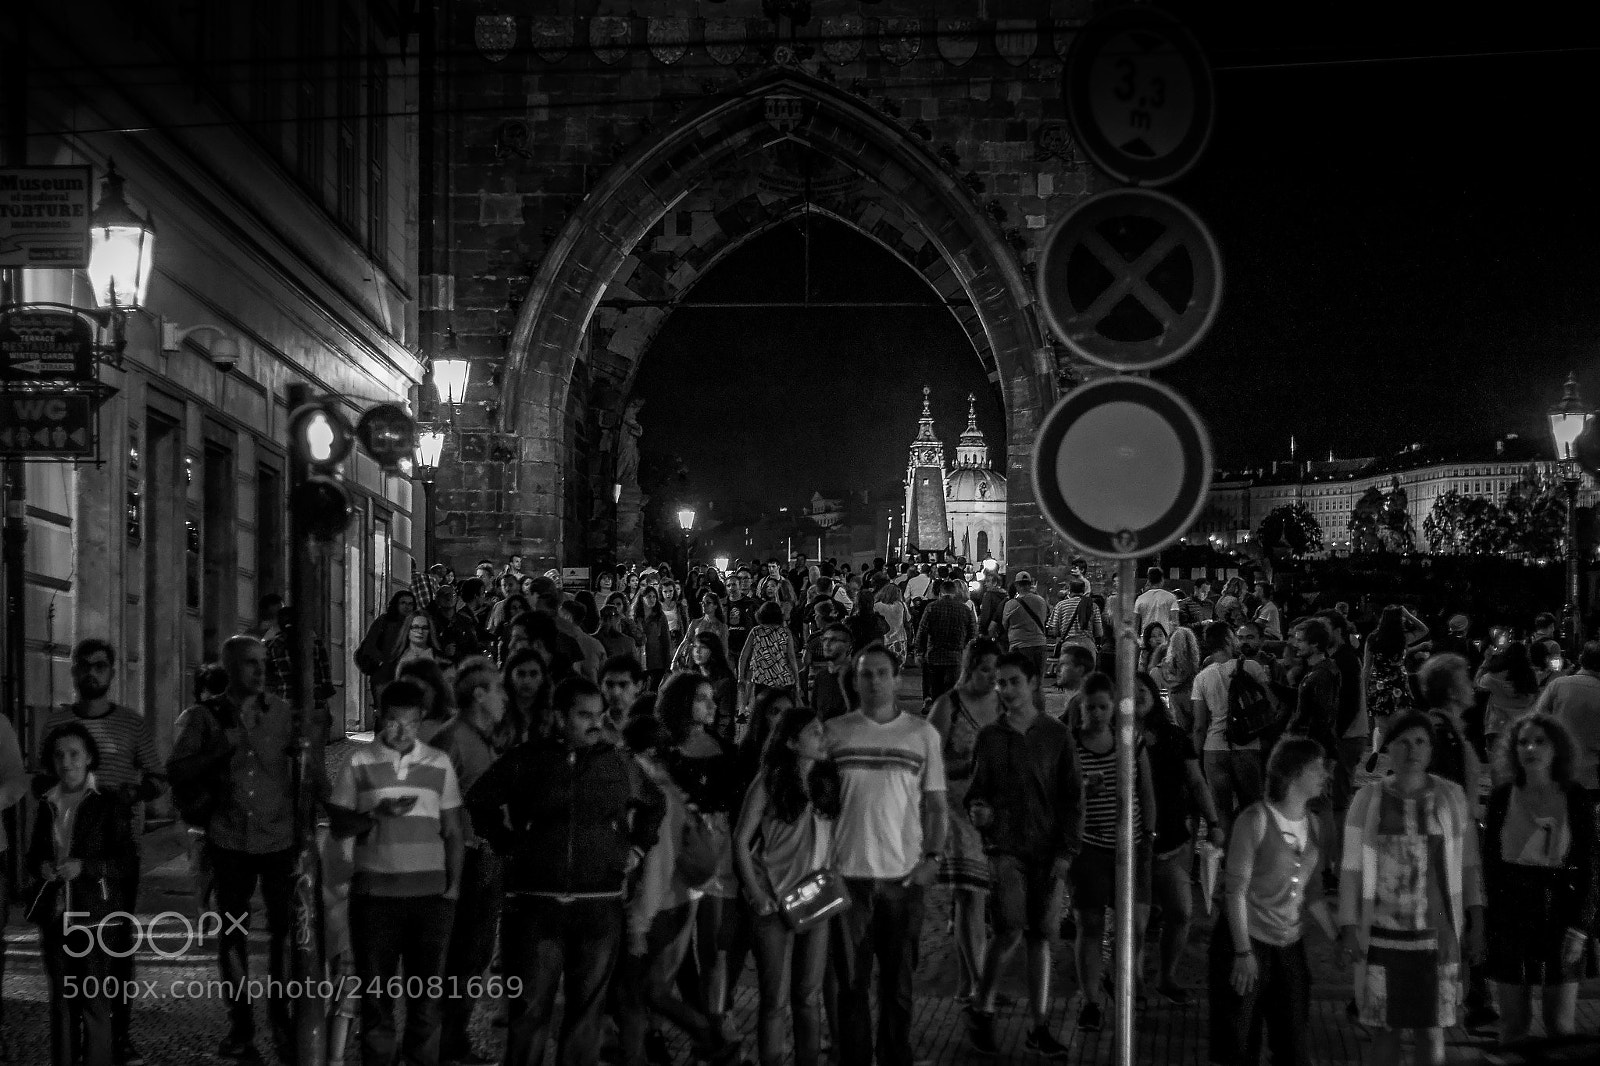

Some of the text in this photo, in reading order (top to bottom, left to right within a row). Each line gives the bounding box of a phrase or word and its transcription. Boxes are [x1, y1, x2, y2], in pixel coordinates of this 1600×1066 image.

[1131, 110, 1150, 130] m
[0, 175, 84, 190] Museum
[23, 192, 70, 201] medieval
[0, 204, 84, 217] TORTURE
[2, 342, 80, 352] RESTAURANT
[9, 352, 75, 360] WINTER GARDEN
[13, 400, 68, 420] WC
